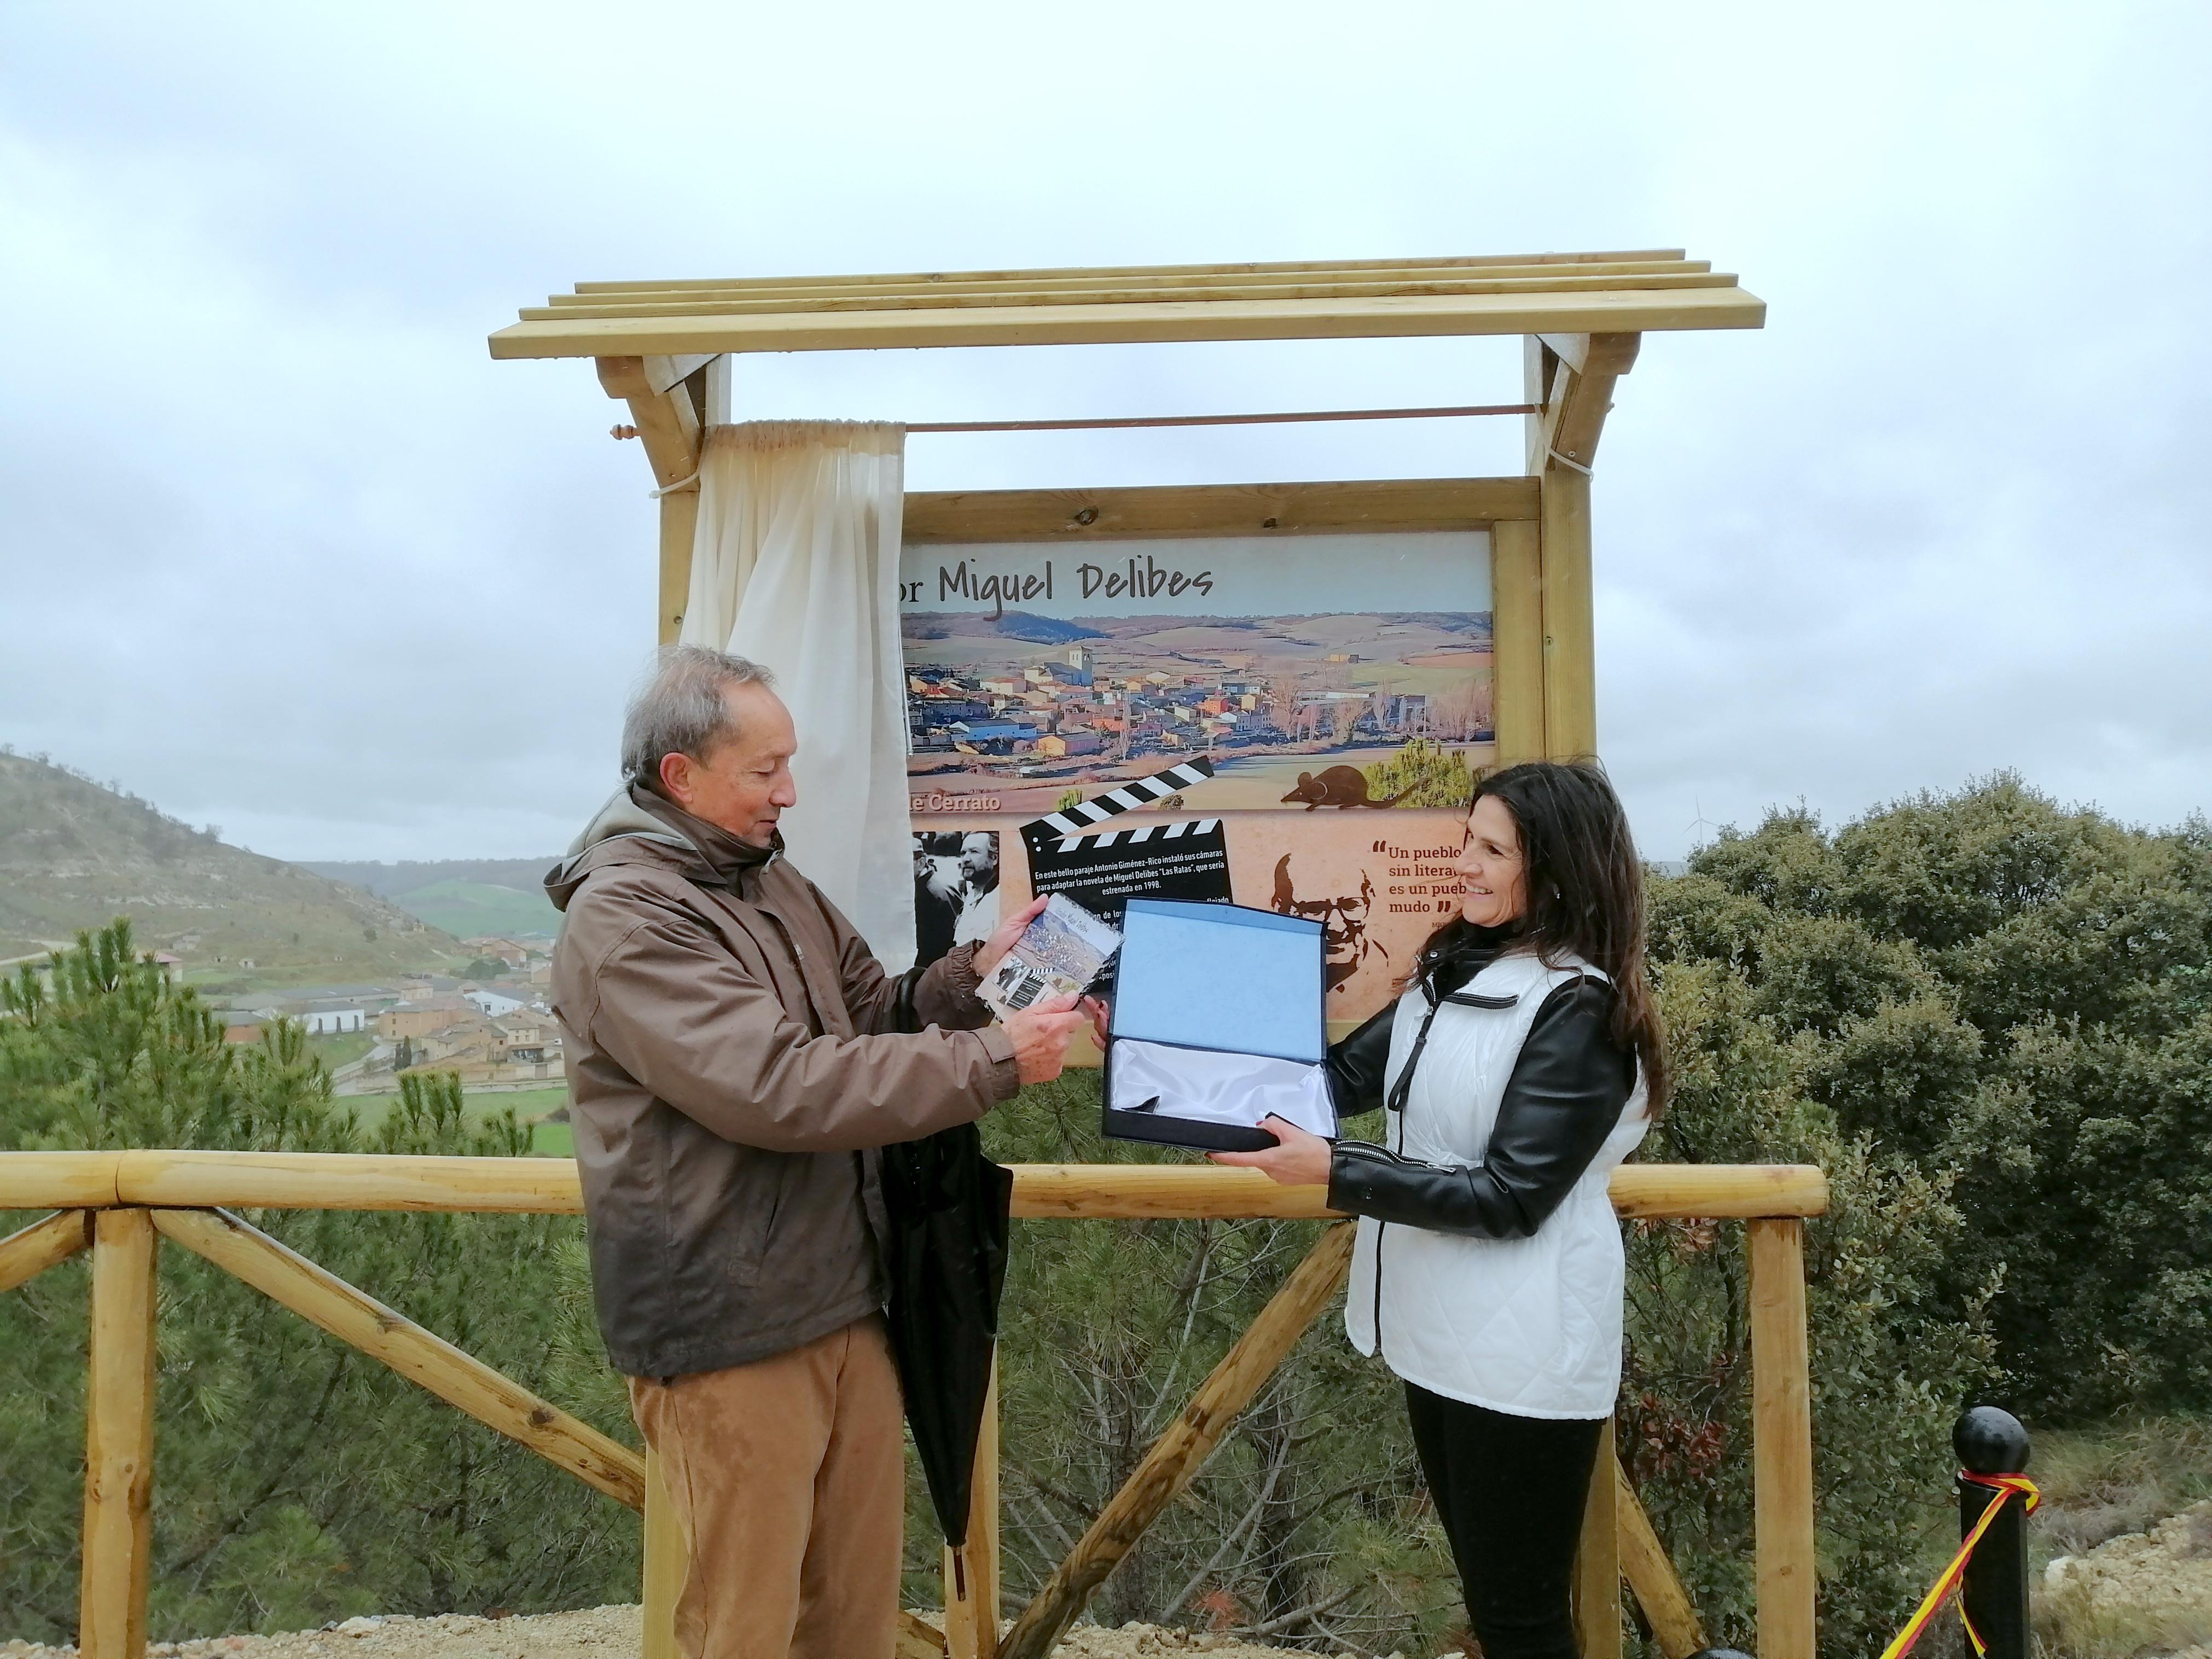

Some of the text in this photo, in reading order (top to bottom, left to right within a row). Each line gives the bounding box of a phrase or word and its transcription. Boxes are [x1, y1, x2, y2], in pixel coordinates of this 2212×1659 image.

[939, 559, 1052, 622] Miguel
[1076, 554, 1215, 600] Delibes
[928, 794, 1001, 811] Cerrato
[1413, 846, 1461, 861] pueblo
[1035, 872, 1043, 880] En
[1043, 870, 1057, 879] este
[1057, 868, 1073, 877] bello
[1074, 865, 1094, 877] paraje
[1094, 862, 1118, 872] Antonio
[1118, 857, 1162, 869] Giménez-Rico
[1162, 854, 1184, 863] instaló
[1196, 850, 1223, 859] cámaras
[1389, 865, 1410, 877] sin
[1036, 884, 1050, 893] para
[1052, 880, 1075, 890] adaptar
[1076, 878, 1083, 886] la
[1083, 876, 1104, 885] novela
[1105, 875, 1112, 883] de
[1113, 872, 1135, 883] Miguel
[1135, 869, 1159, 879] Delibes
[1196, 864, 1208, 873] que
[1208, 860, 1224, 869] sería
[1102, 884, 1133, 895] estrenada
[1143, 880, 1162, 890] 1998.
[1389, 883, 1466, 897] es un pueb
[1103, 911, 1111, 919] de
